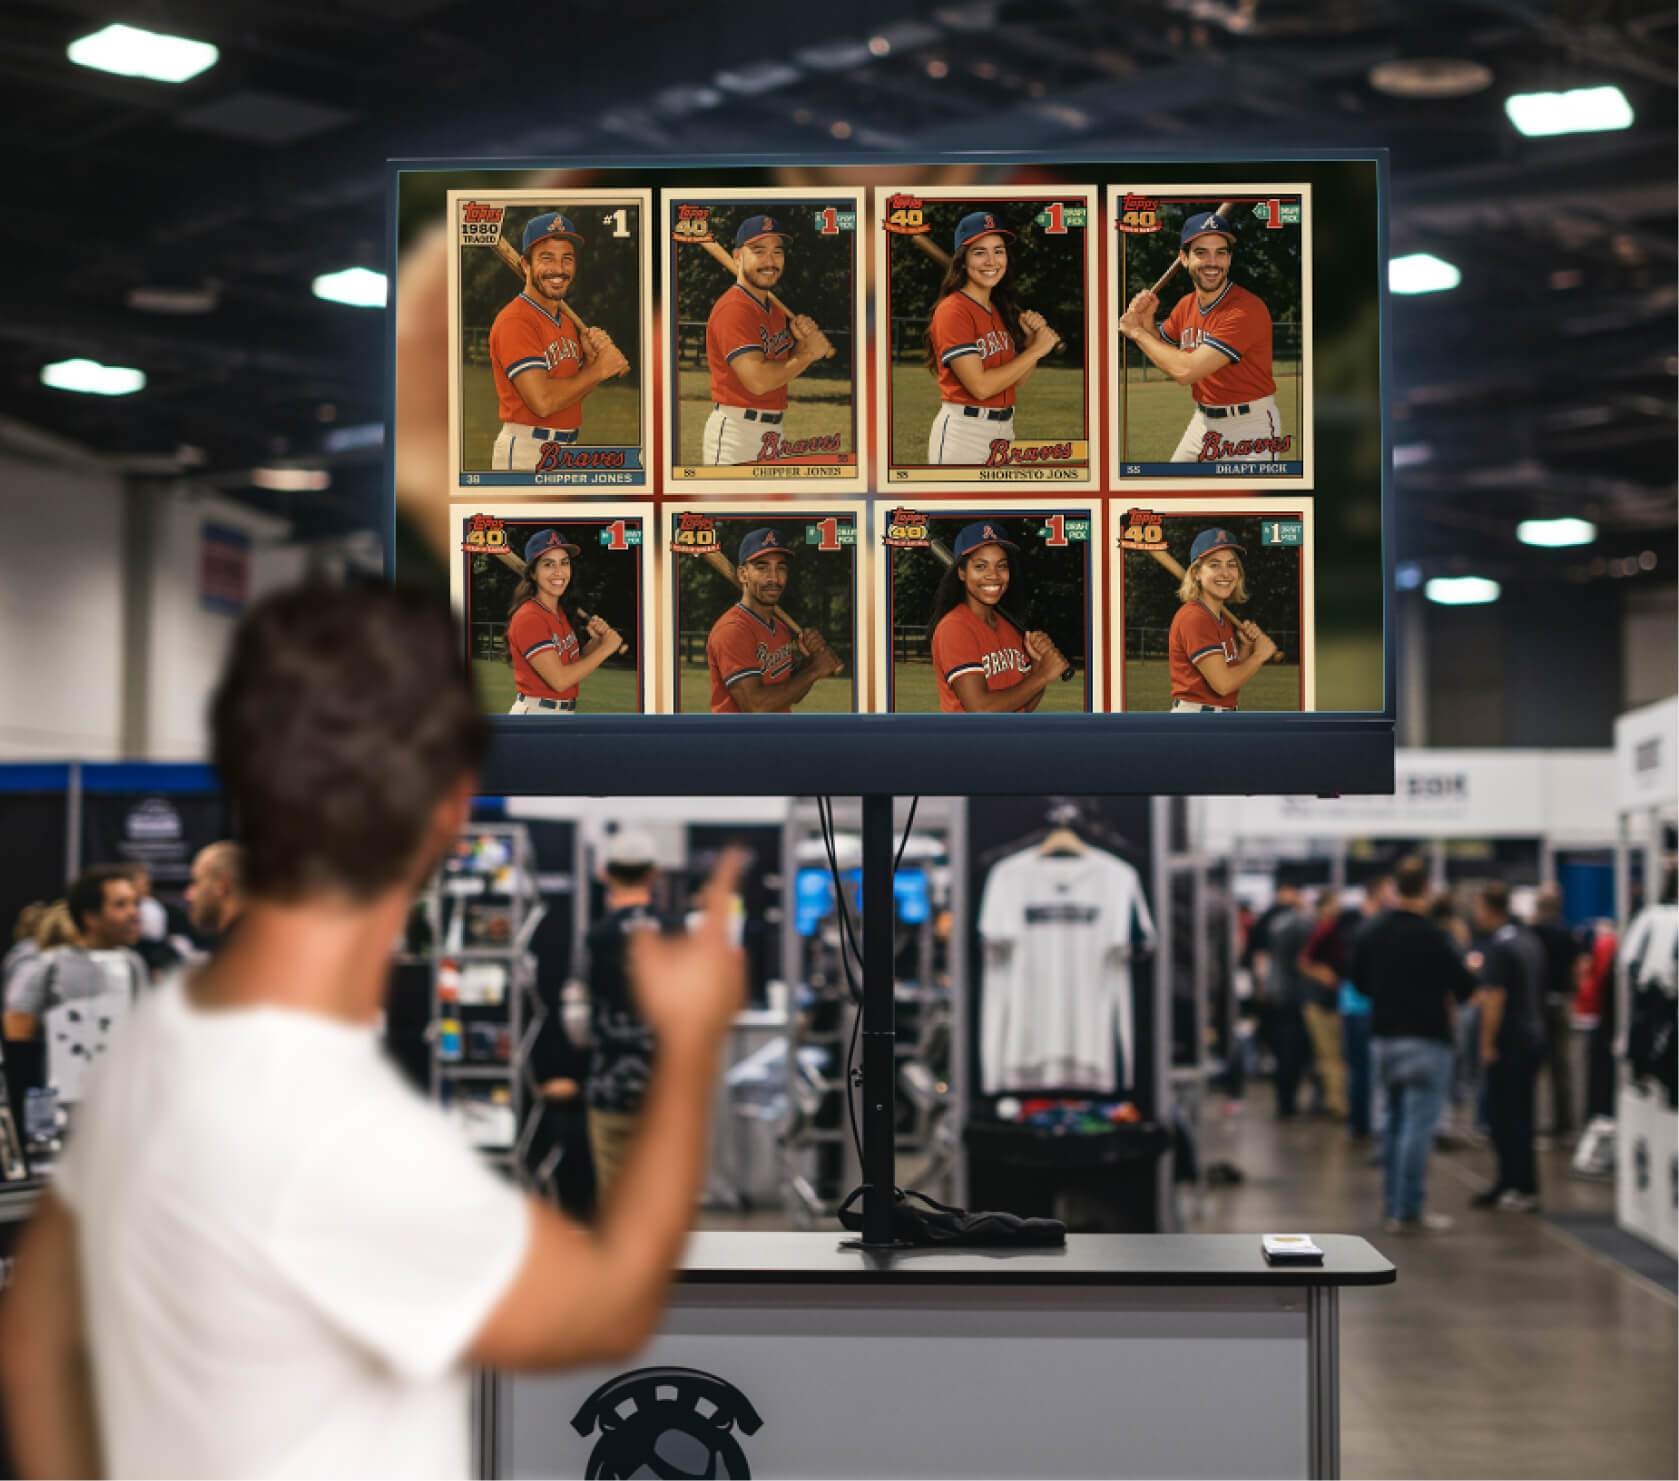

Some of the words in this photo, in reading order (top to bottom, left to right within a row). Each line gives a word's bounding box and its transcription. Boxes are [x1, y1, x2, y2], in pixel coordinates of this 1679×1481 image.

[1122, 192, 1160, 211] Topps
[602, 208, 630, 238] #1
[890, 210, 923, 226] 40
[1122, 211, 1157, 227] 40
[1200, 215, 1217, 230] A
[461, 224, 498, 235] 1980
[675, 219, 708, 235] 40
[757, 431, 841, 462] Braves
[985, 439, 1073, 468] Braves
[1197, 431, 1291, 462] Braves
[535, 441, 625, 473] Braves
[804, 467, 841, 477] JONES
[1215, 464, 1257, 474] DRAFT
[1259, 463, 1288, 473] PICK
[535, 474, 587, 484] CHIPPER
[591, 473, 633, 483] JONES
[892, 506, 929, 525] Topps
[468, 530, 505, 546] 40
[677, 530, 713, 545] 40
[1125, 525, 1162, 543] 40
